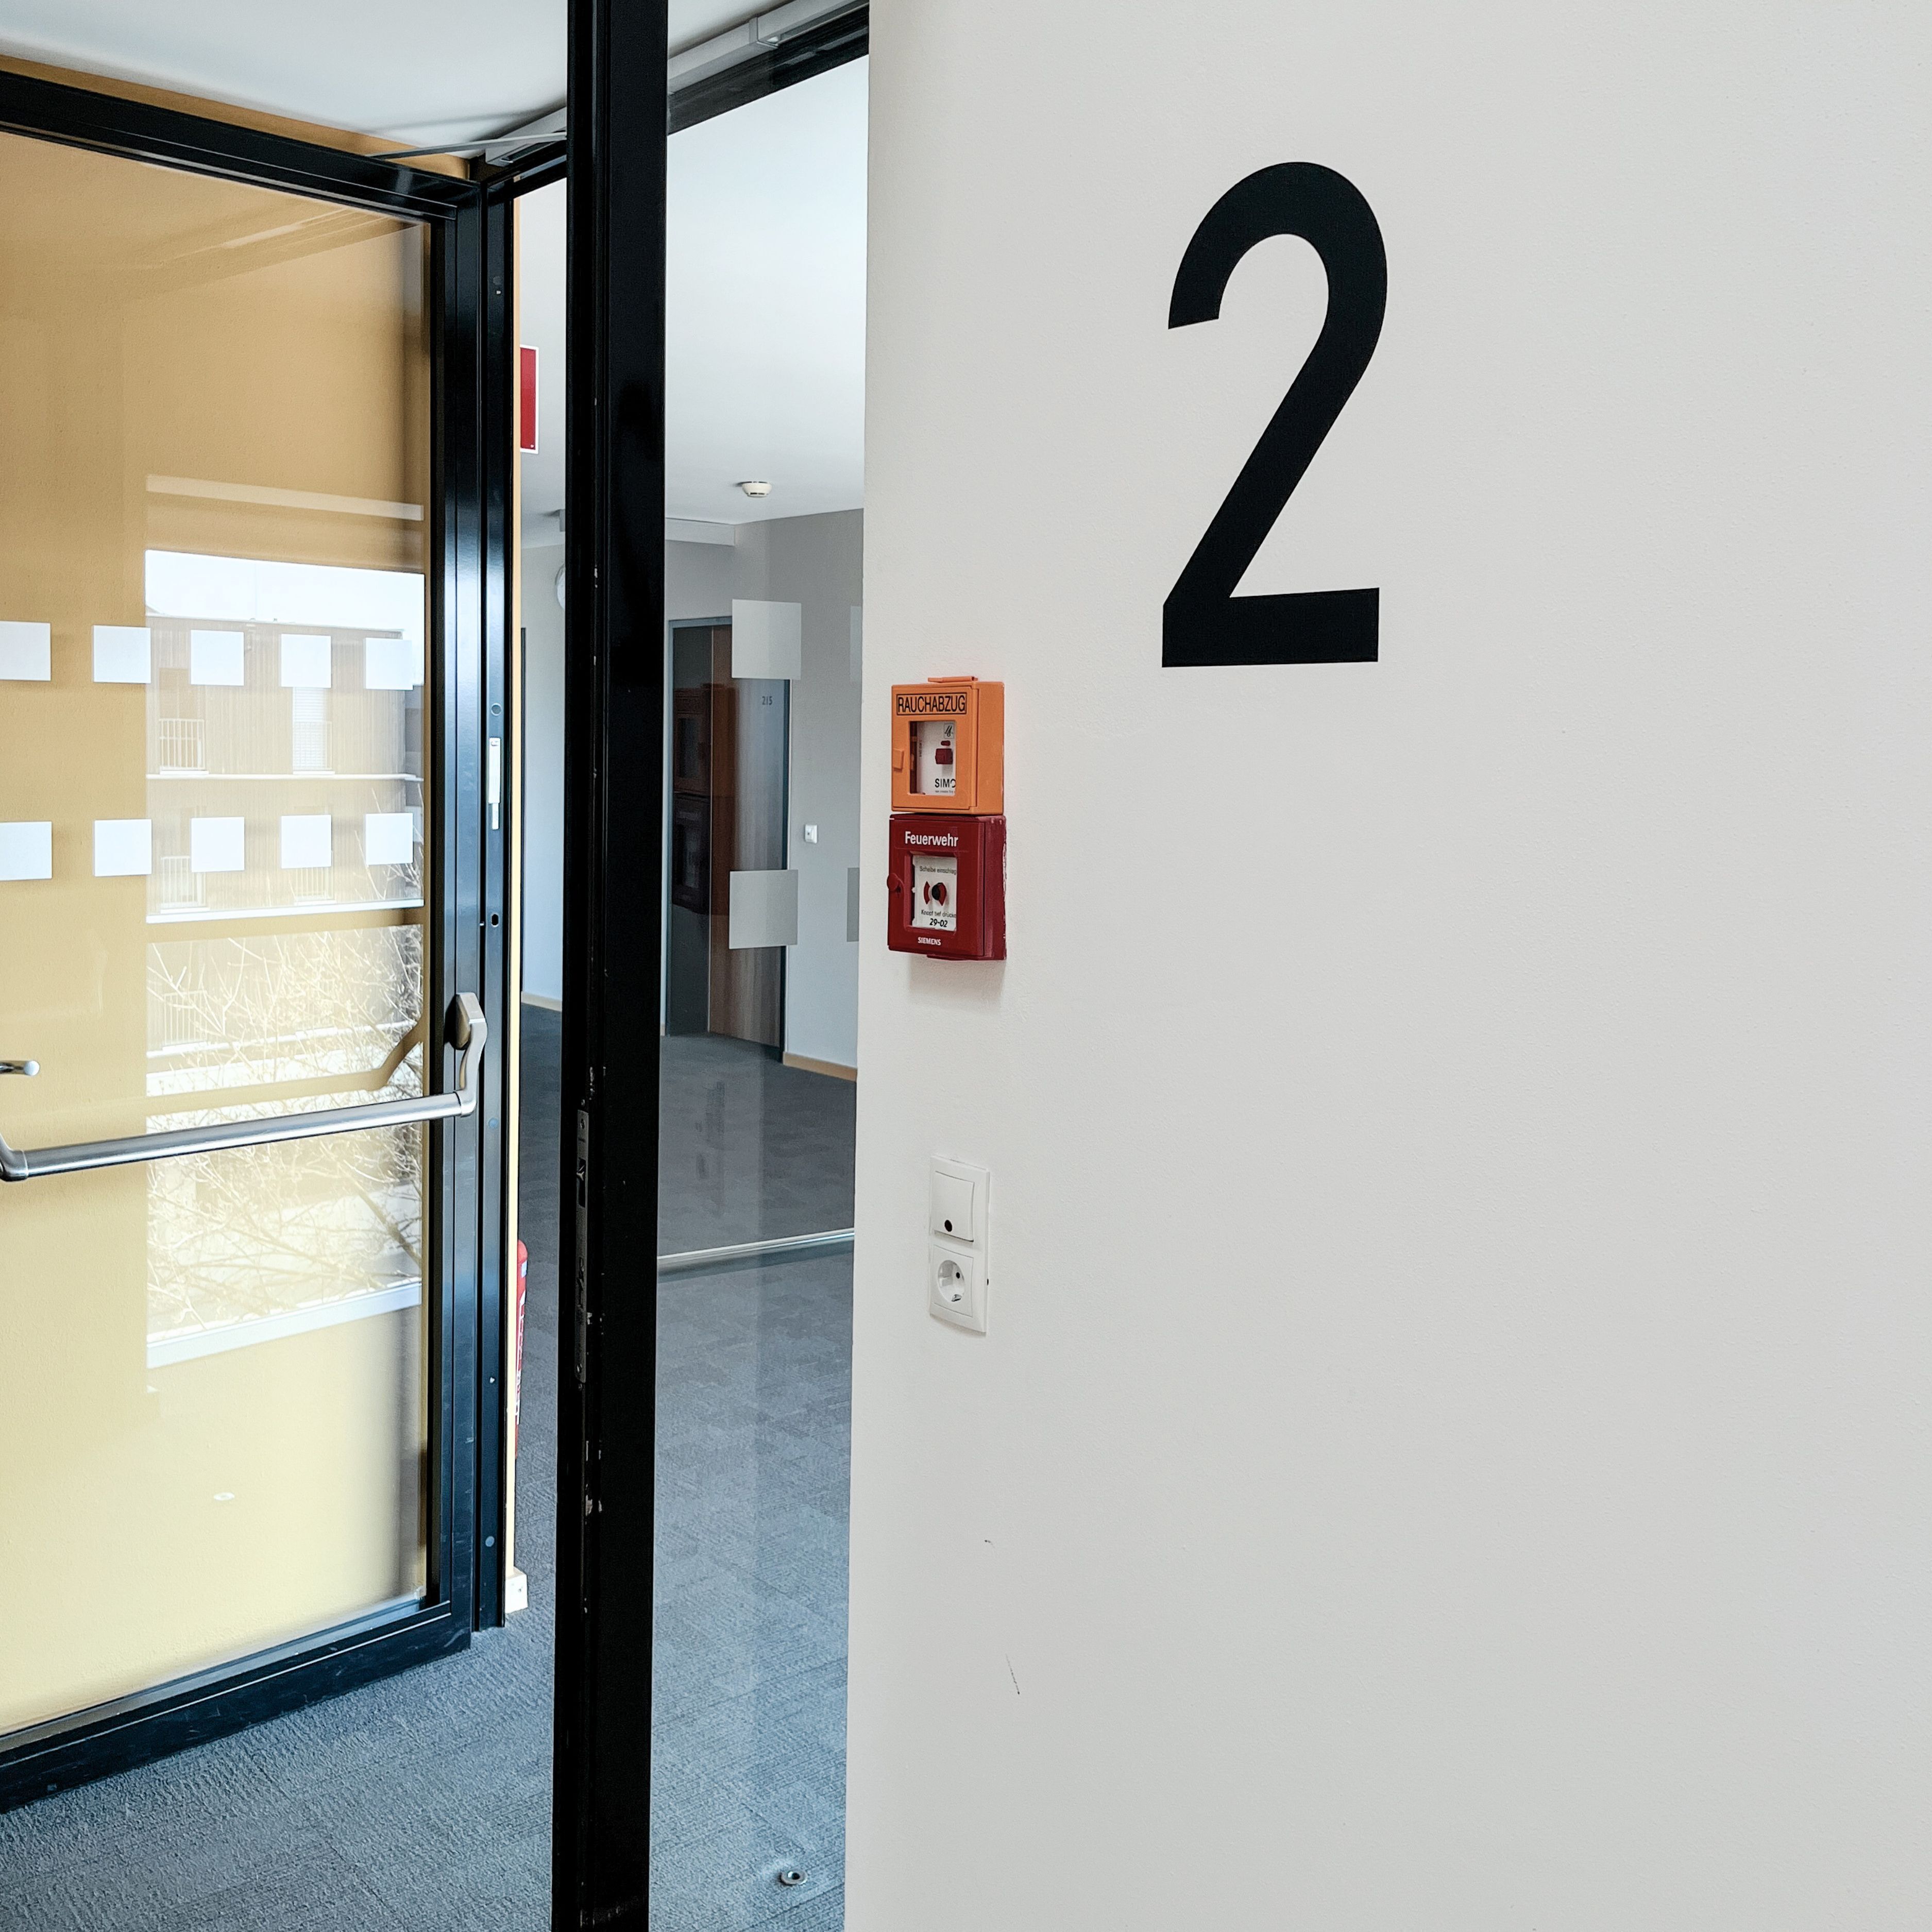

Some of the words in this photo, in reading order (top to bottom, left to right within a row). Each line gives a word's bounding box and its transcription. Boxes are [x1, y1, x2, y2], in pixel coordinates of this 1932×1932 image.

[1162, 161, 1387, 667] 2
[762, 696, 773, 705] 215
[898, 695, 965, 713] RAUCHABZUG
[905, 831, 959, 847] Feuerwehr
[929, 918, 948, 927] 29-02
[918, 937, 941, 945] SIEMENS
